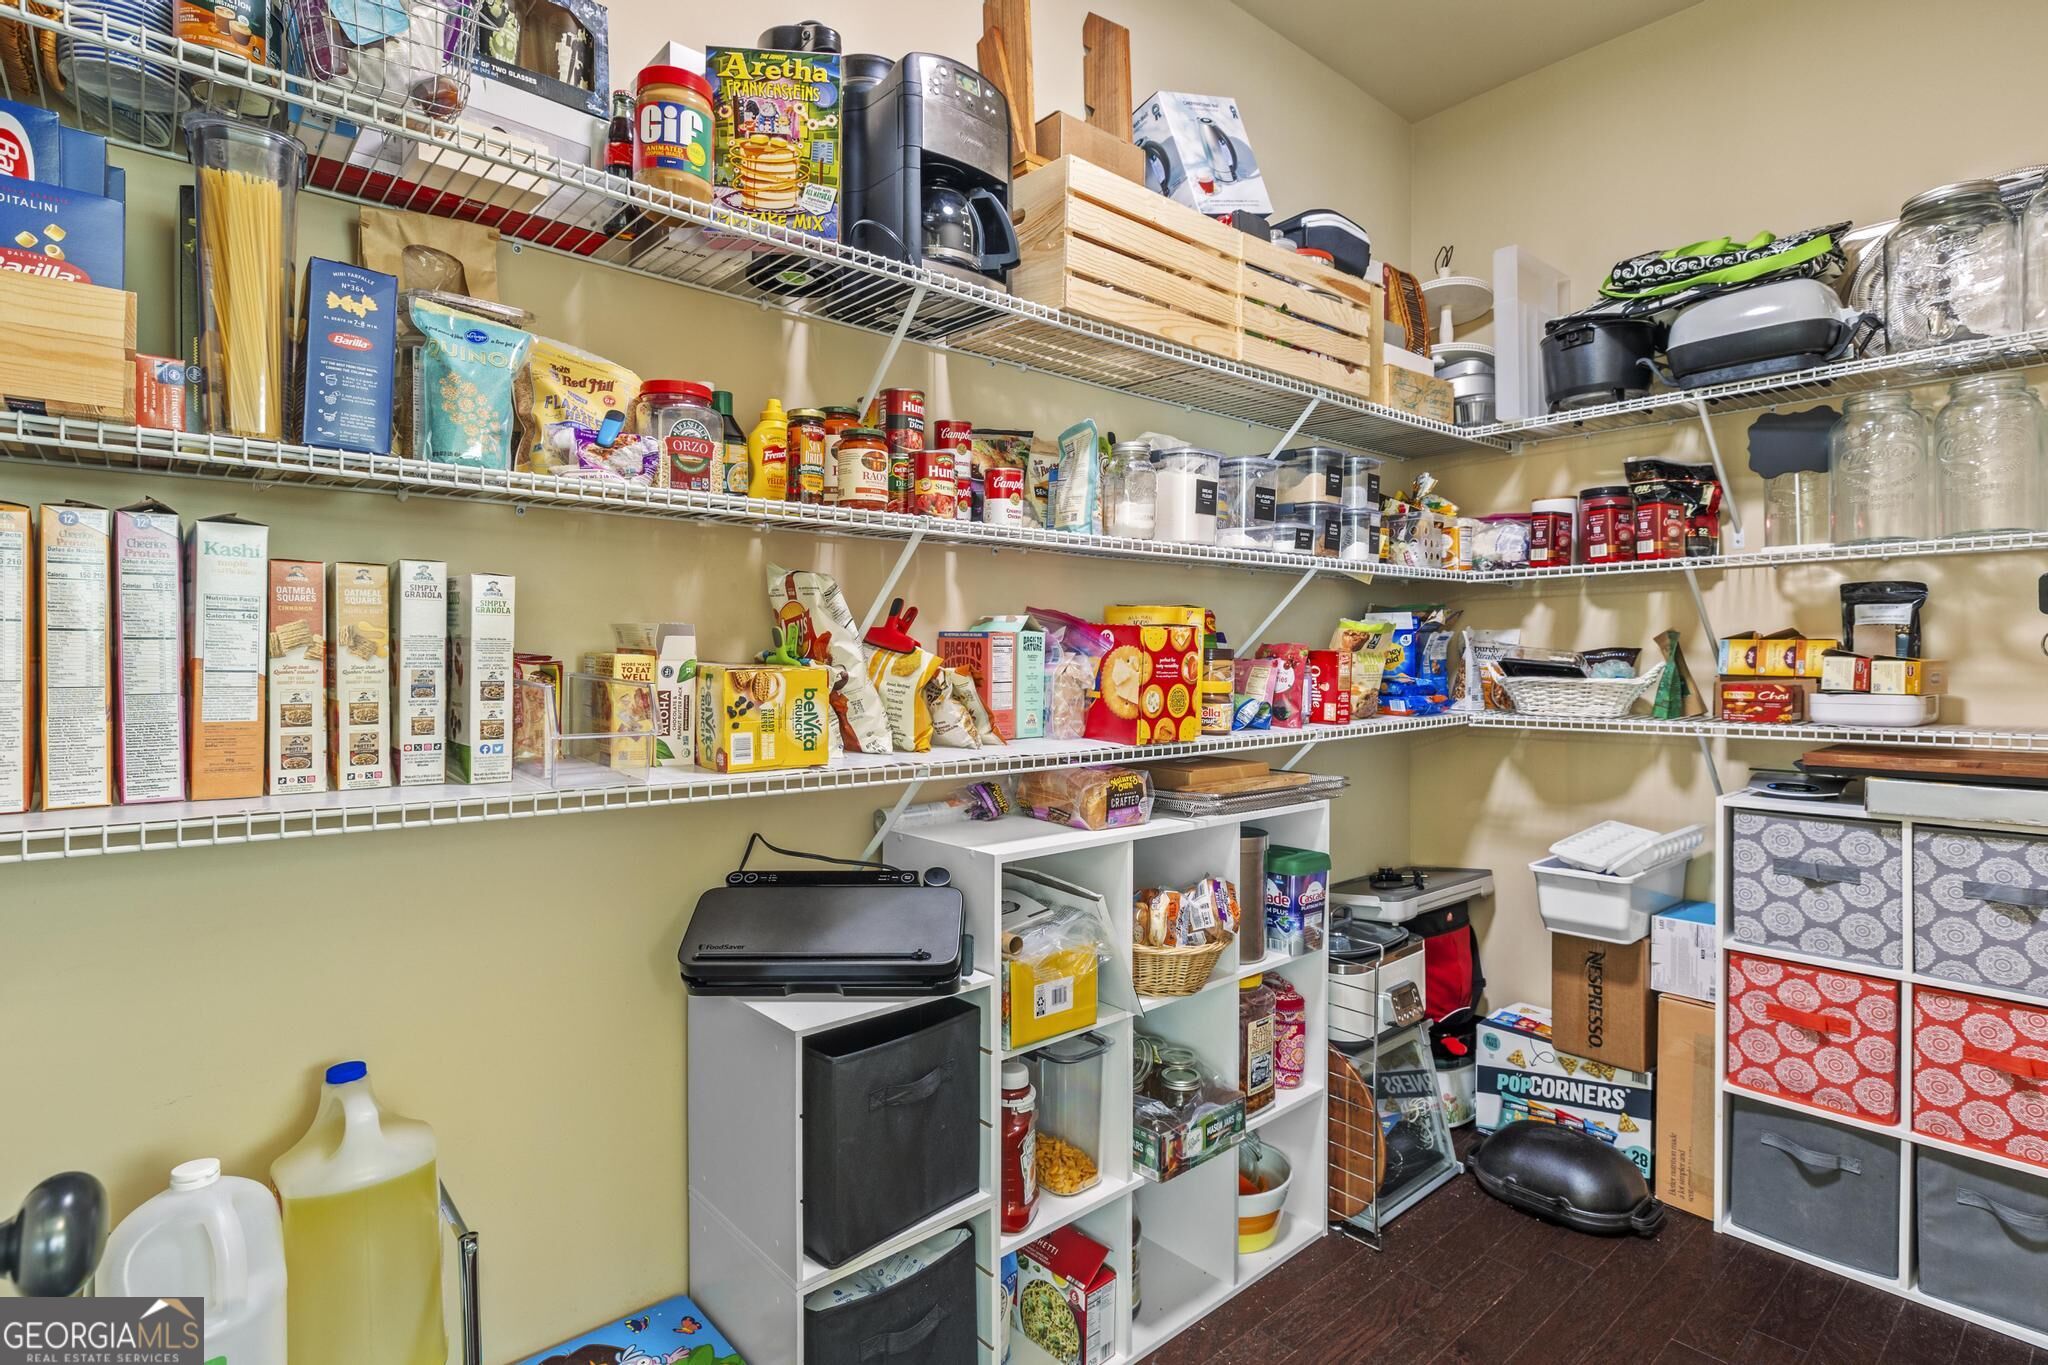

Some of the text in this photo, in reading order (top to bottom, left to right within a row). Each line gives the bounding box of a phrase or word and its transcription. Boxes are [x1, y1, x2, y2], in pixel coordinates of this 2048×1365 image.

[480, 61, 490, 69] OF
[491, 64, 507, 75] TWO
[508, 70, 538, 85] GLASSES
[717, 51, 831, 83] Aretha
[640, 104, 704, 147] Gif
[646, 144, 684, 154] ANIMATED
[805, 188, 833, 201] ALL NATURAL
[792, 214, 826, 232] MIX
[7, 250, 49, 262] DAL 1877
[347, 272, 375, 286] FARFALLE
[333, 335, 369, 349] Barilla
[561, 375, 615, 394] Red Mill
[902, 401, 925, 413] Hun
[672, 421, 707, 439] RICESELECT
[940, 427, 972, 441] Campb
[673, 440, 709, 454] ORZO
[928, 466, 955, 478] Hun
[993, 477, 1024, 490] Campb
[126, 537, 168, 549] Cheerios
[203, 540, 260, 559] Kashi
[124, 548, 171, 559] Protein
[275, 585, 317, 595] OATMEAL
[344, 588, 383, 597] OATMEAL
[409, 584, 438, 592] SIMPLY
[275, 594, 317, 603] SQUARES
[344, 596, 383, 605] SQUARES
[404, 591, 443, 599] GRANOLA
[1023, 636, 1043, 645] BACK TO
[944, 641, 982, 658] BACK TO
[1023, 643, 1042, 652] NATURE
[621, 673, 651, 681] WELL
[1311, 665, 1324, 708] Orville
[1757, 690, 1789, 700] Chai
[660, 691, 671, 735] ALOHA
[1202, 707, 1221, 717] ella
[767, 708, 775, 732] STEADY
[794, 698, 803, 741] CRUNCHY
[803, 688, 823, 751] belVita
[1110, 773, 1142, 789] Nature's
[1118, 781, 1134, 791] Own
[1110, 794, 1140, 809] CRAFTED
[1298, 892, 1326, 906] Cascade
[1273, 907, 1289, 916] PLUS
[1206, 1114, 1235, 1135] MASON JARS
[1133, 1139, 1144, 1152] ARS
[1632, 1150, 1648, 1168] 28
[1037, 1238, 1059, 1256] HETTI
[1071, 1291, 1077, 1301] 6
